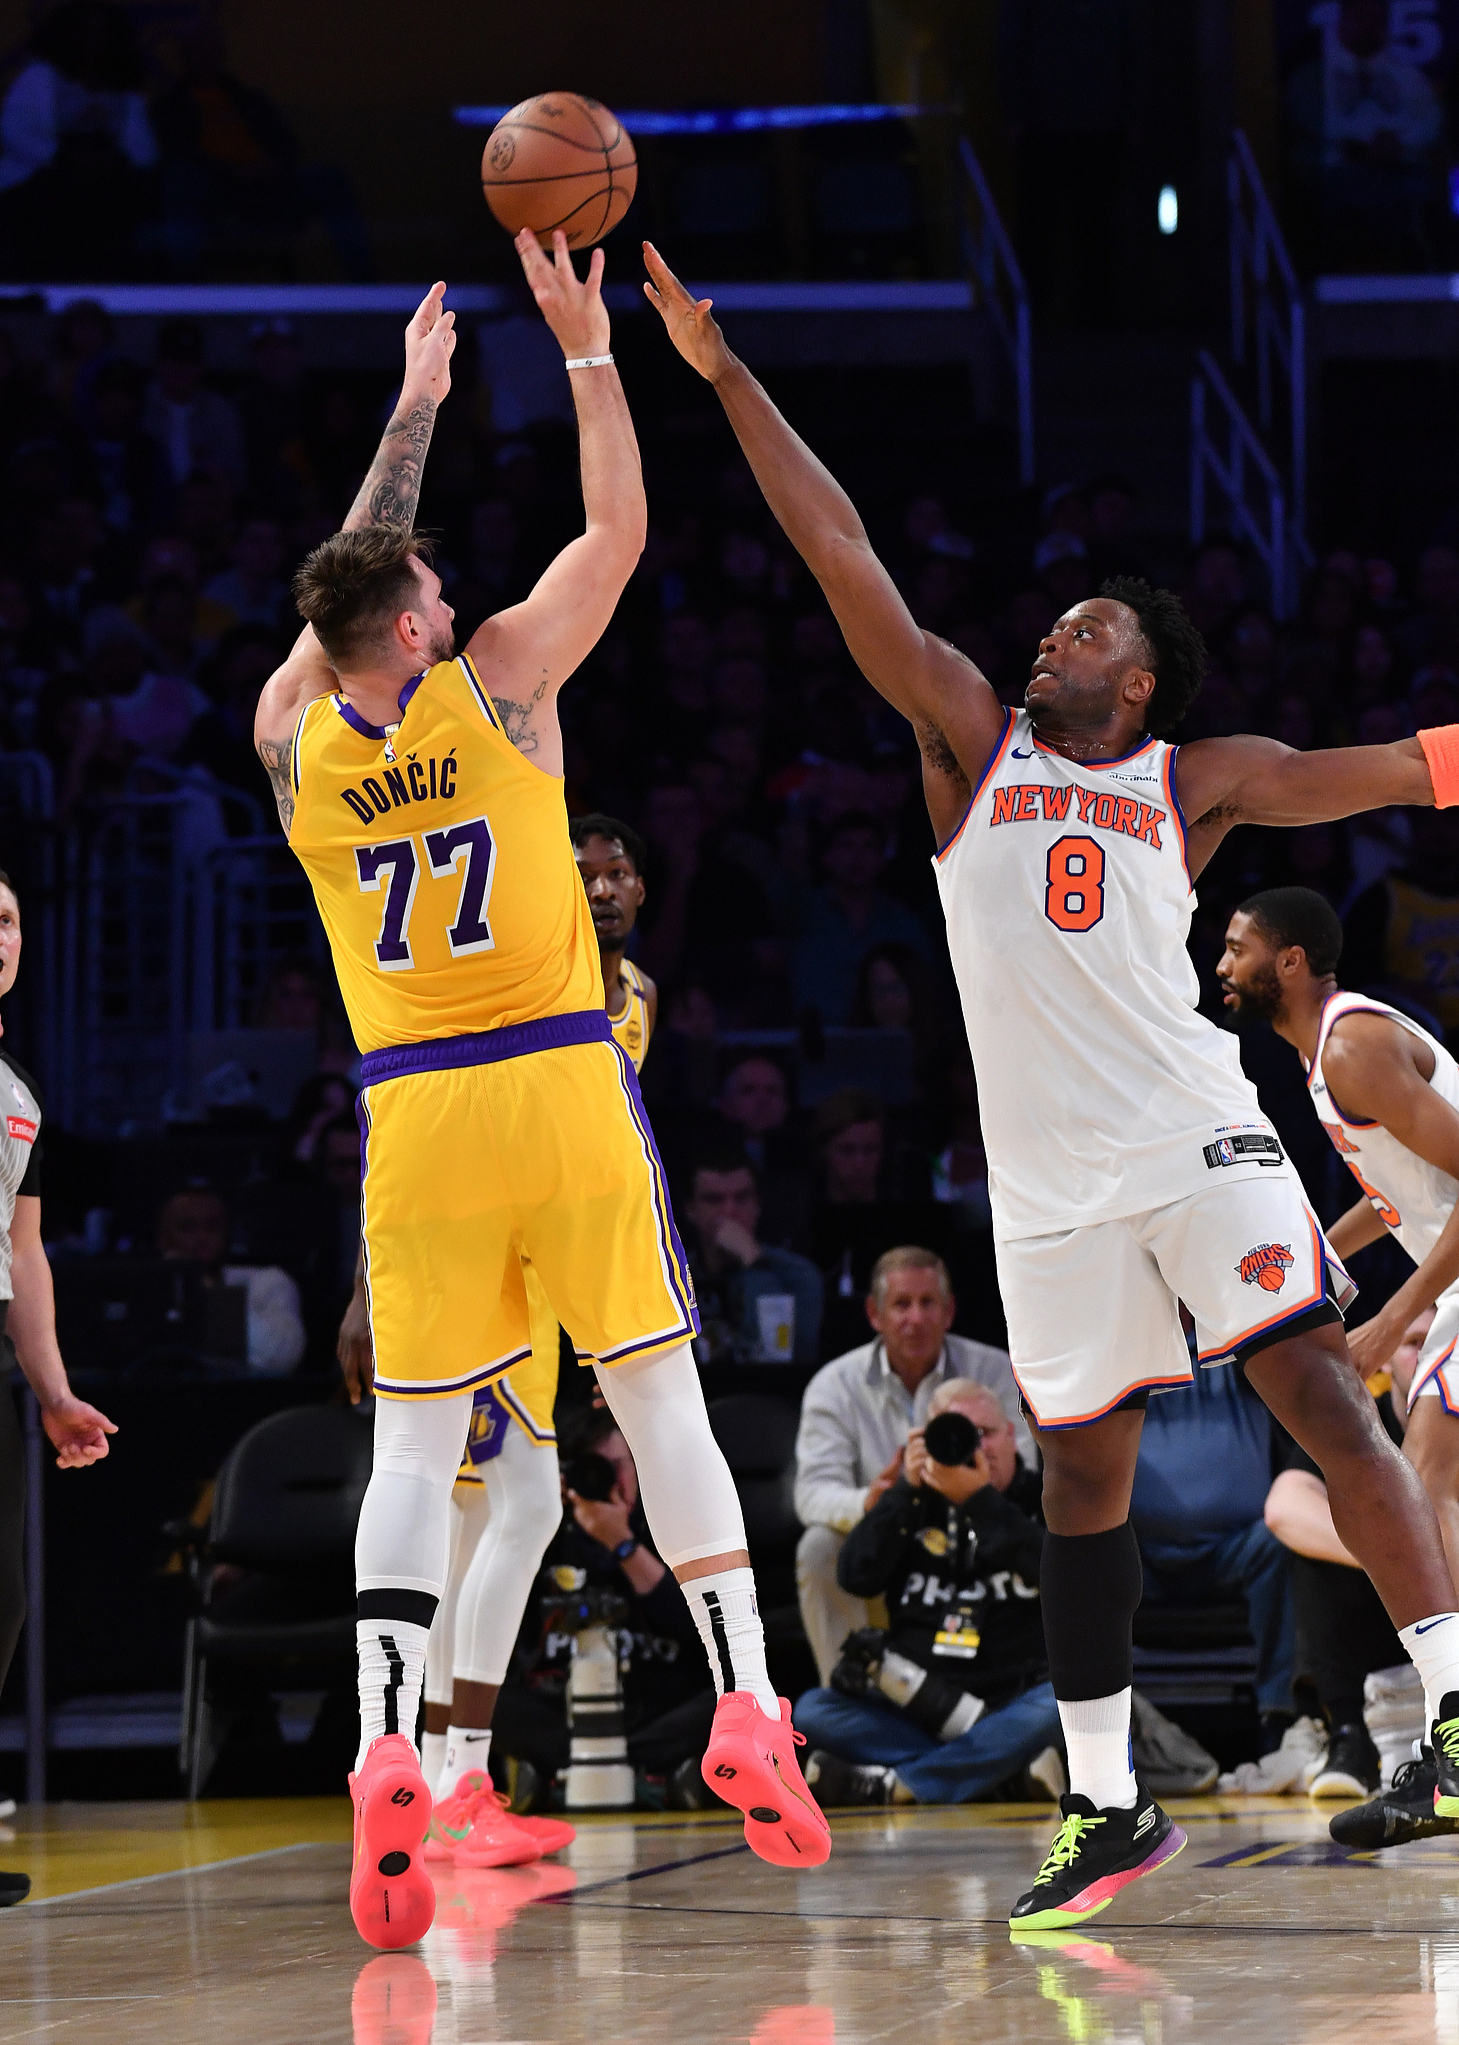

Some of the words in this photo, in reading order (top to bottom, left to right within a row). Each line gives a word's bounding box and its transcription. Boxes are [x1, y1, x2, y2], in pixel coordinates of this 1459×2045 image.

[340, 748, 457, 826] DONČIĆ
[990, 783, 1074, 829] NEW
[1074, 783, 1167, 853] YORK
[352, 814, 498, 973] 77
[1045, 834, 1106, 933] 8
[1240, 1243, 1295, 1282] KNICKS
